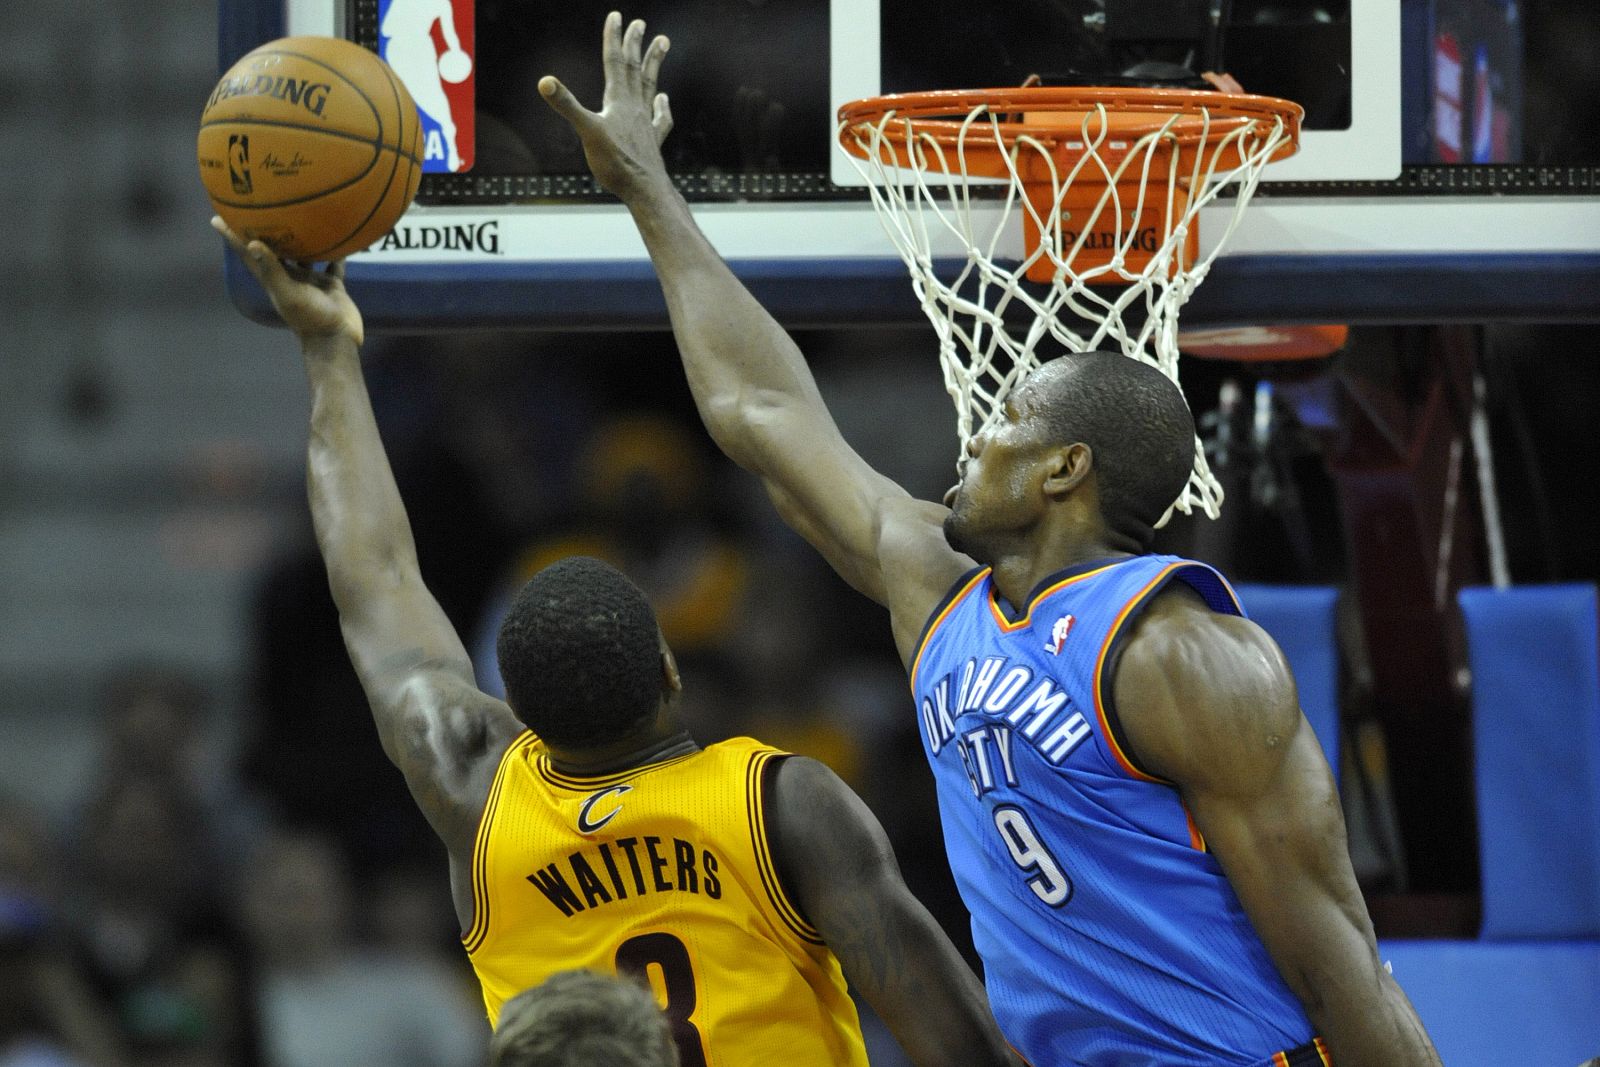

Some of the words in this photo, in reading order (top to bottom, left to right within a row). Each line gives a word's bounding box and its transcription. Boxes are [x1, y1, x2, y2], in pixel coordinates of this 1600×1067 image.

[204, 75, 331, 117] PALDING
[361, 220, 499, 254] ALDING
[922, 656, 1093, 766] OKAHOMA
[956, 725, 1019, 800] CTY
[526, 836, 722, 918] WAITERS
[992, 803, 1073, 908] 9
